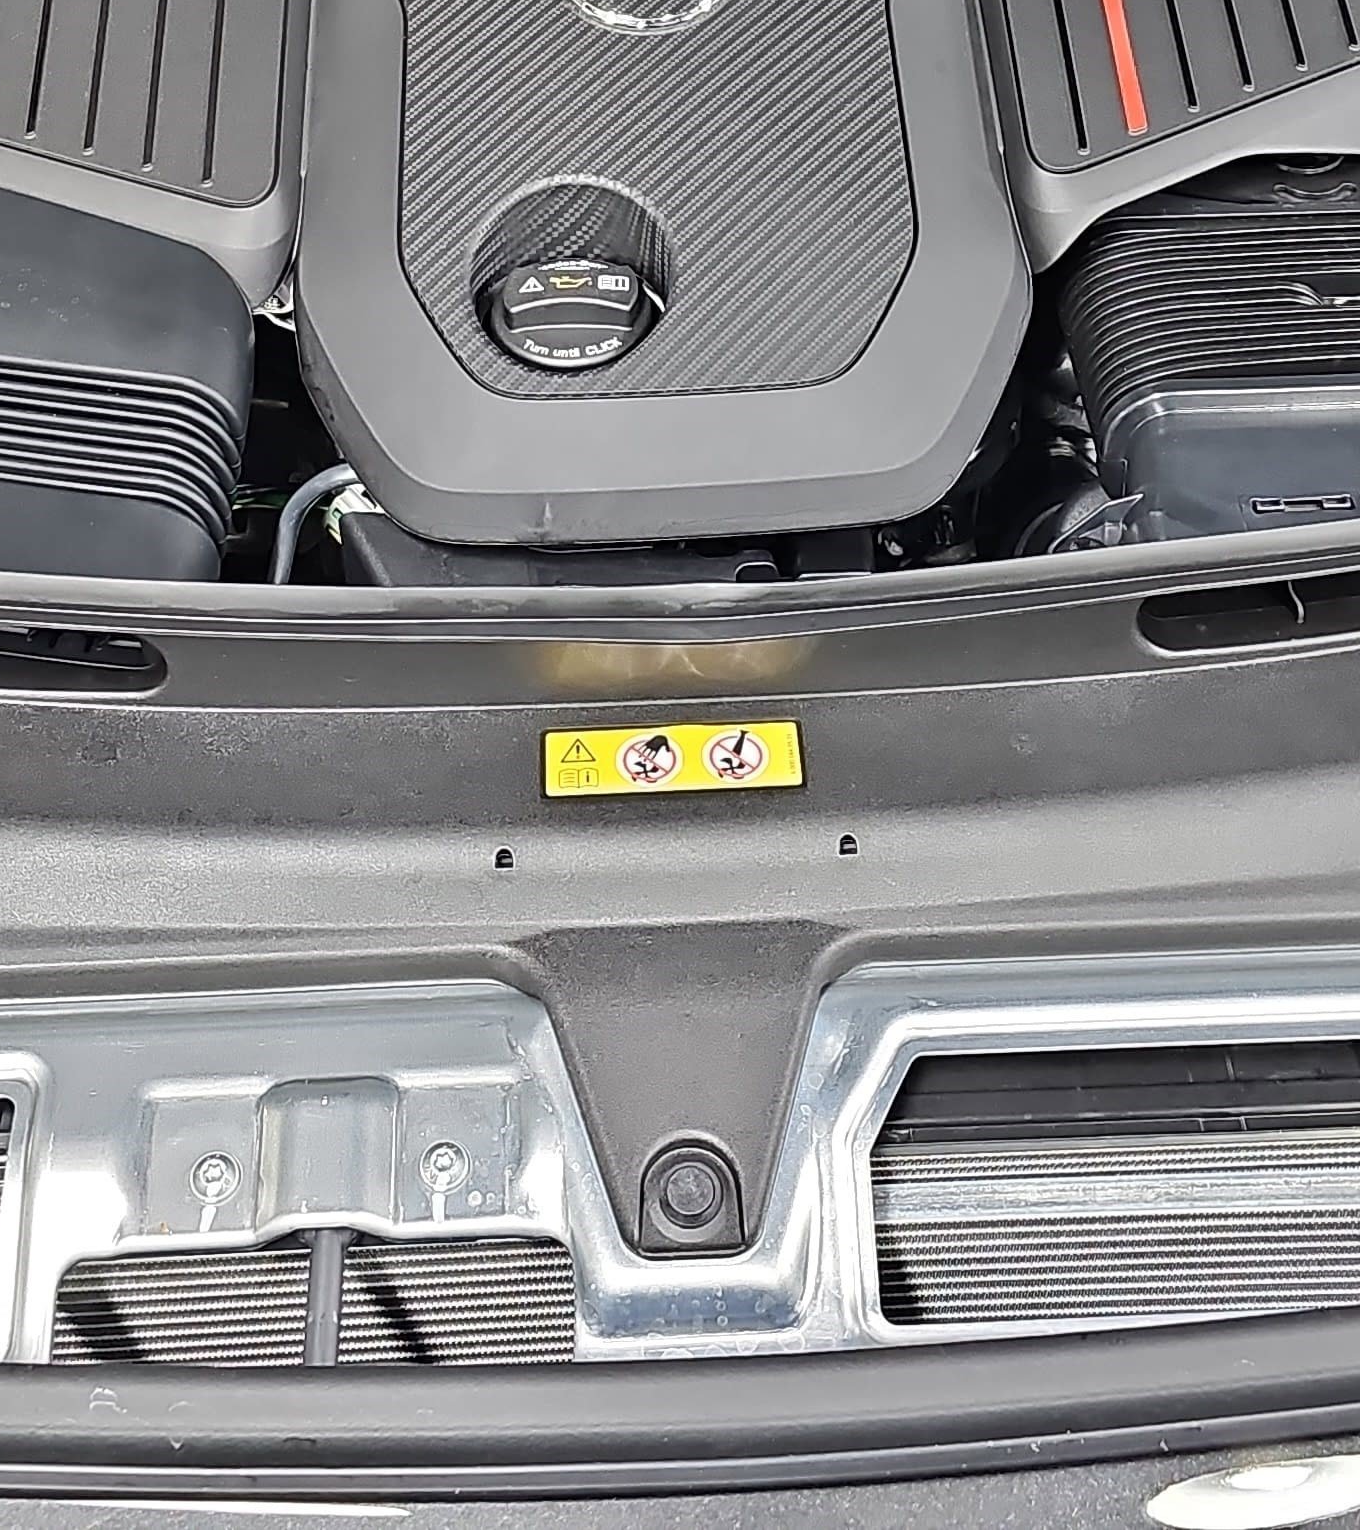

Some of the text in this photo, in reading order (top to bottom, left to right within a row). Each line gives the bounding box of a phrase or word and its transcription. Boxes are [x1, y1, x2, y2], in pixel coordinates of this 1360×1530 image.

[523, 336, 623, 359] Turn until CLICK
